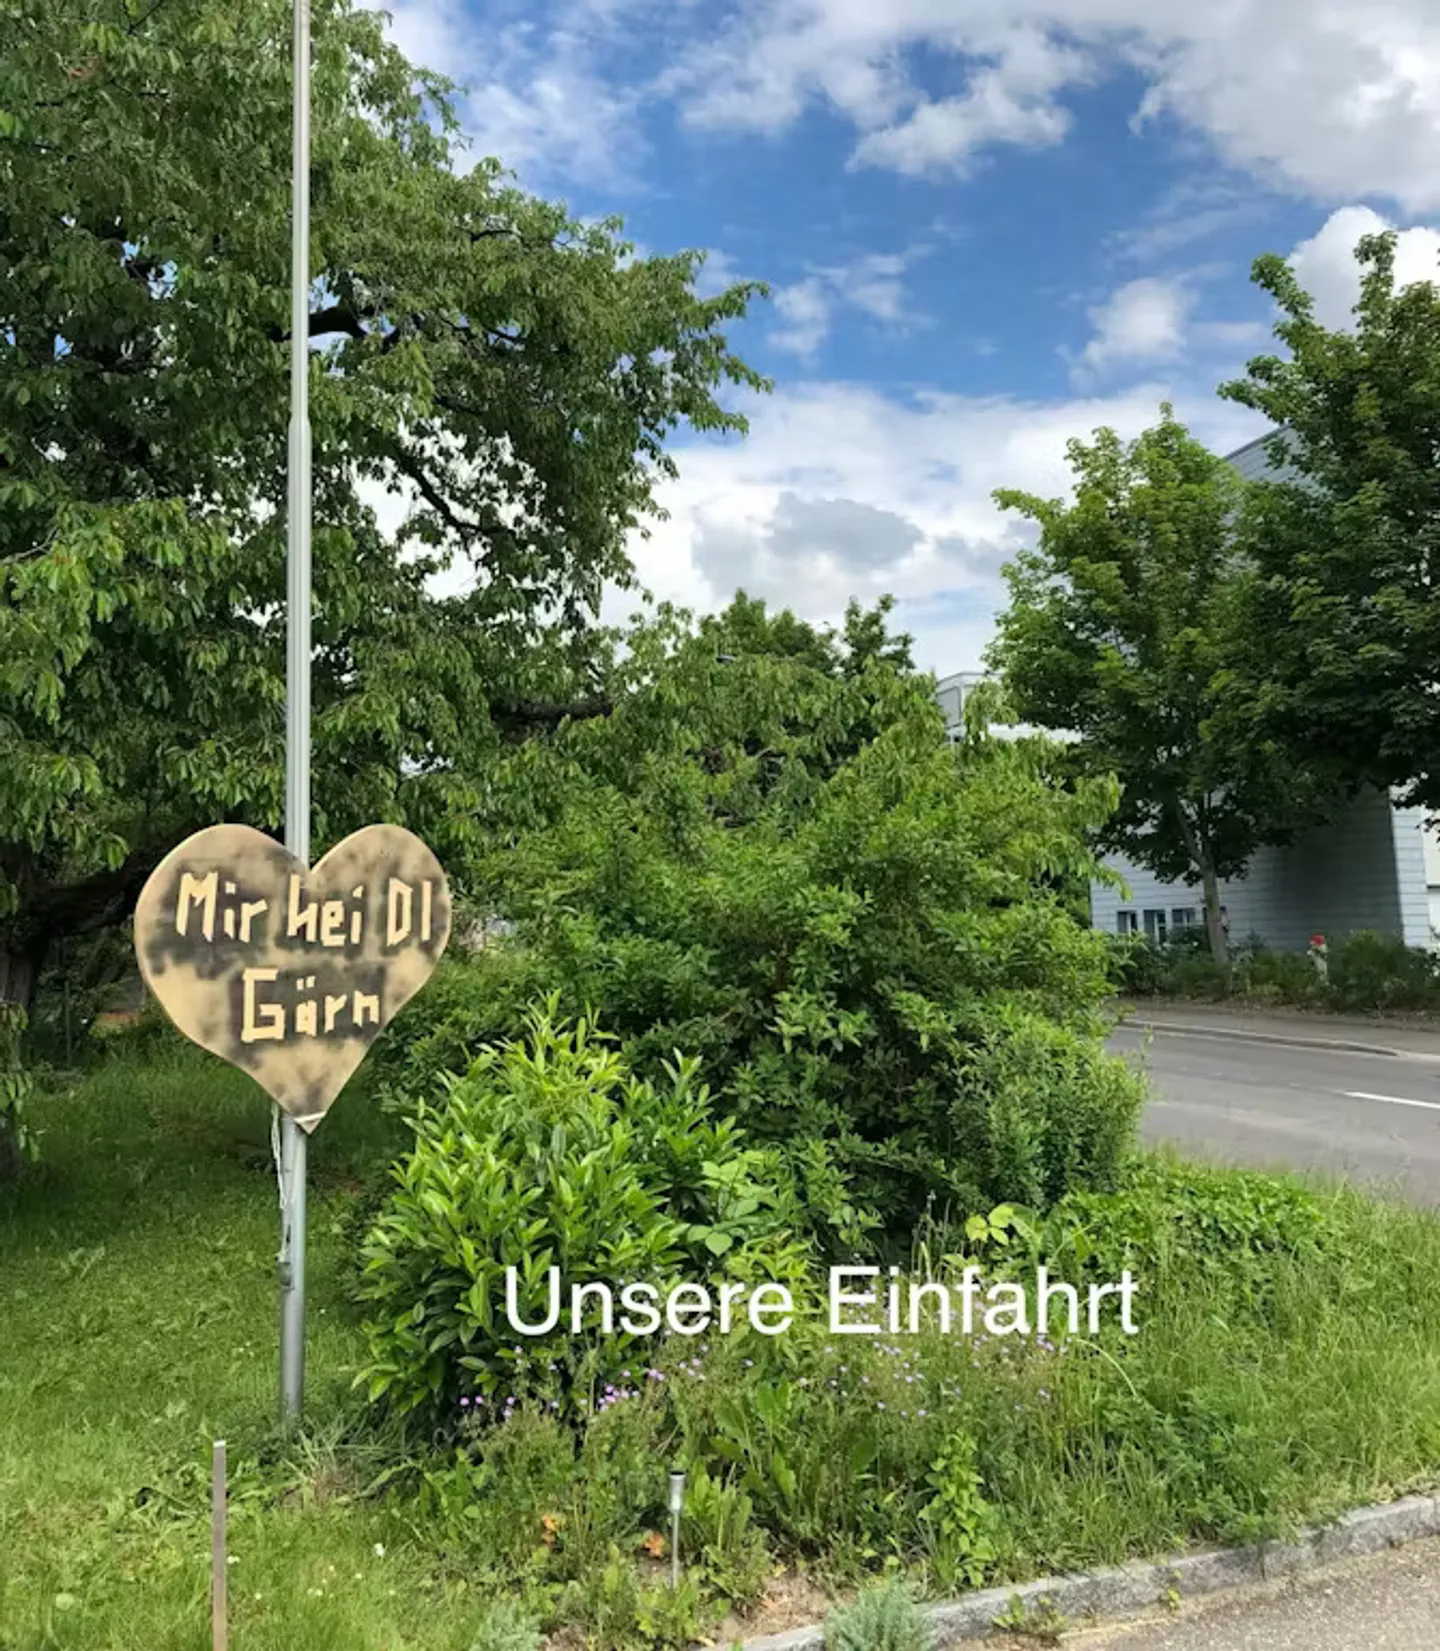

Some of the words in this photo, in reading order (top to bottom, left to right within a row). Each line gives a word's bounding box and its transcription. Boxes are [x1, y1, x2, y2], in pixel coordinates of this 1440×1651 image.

[176, 871, 268, 943] Mir
[287, 874, 364, 947] hei
[241, 968, 380, 1043] Gärn
